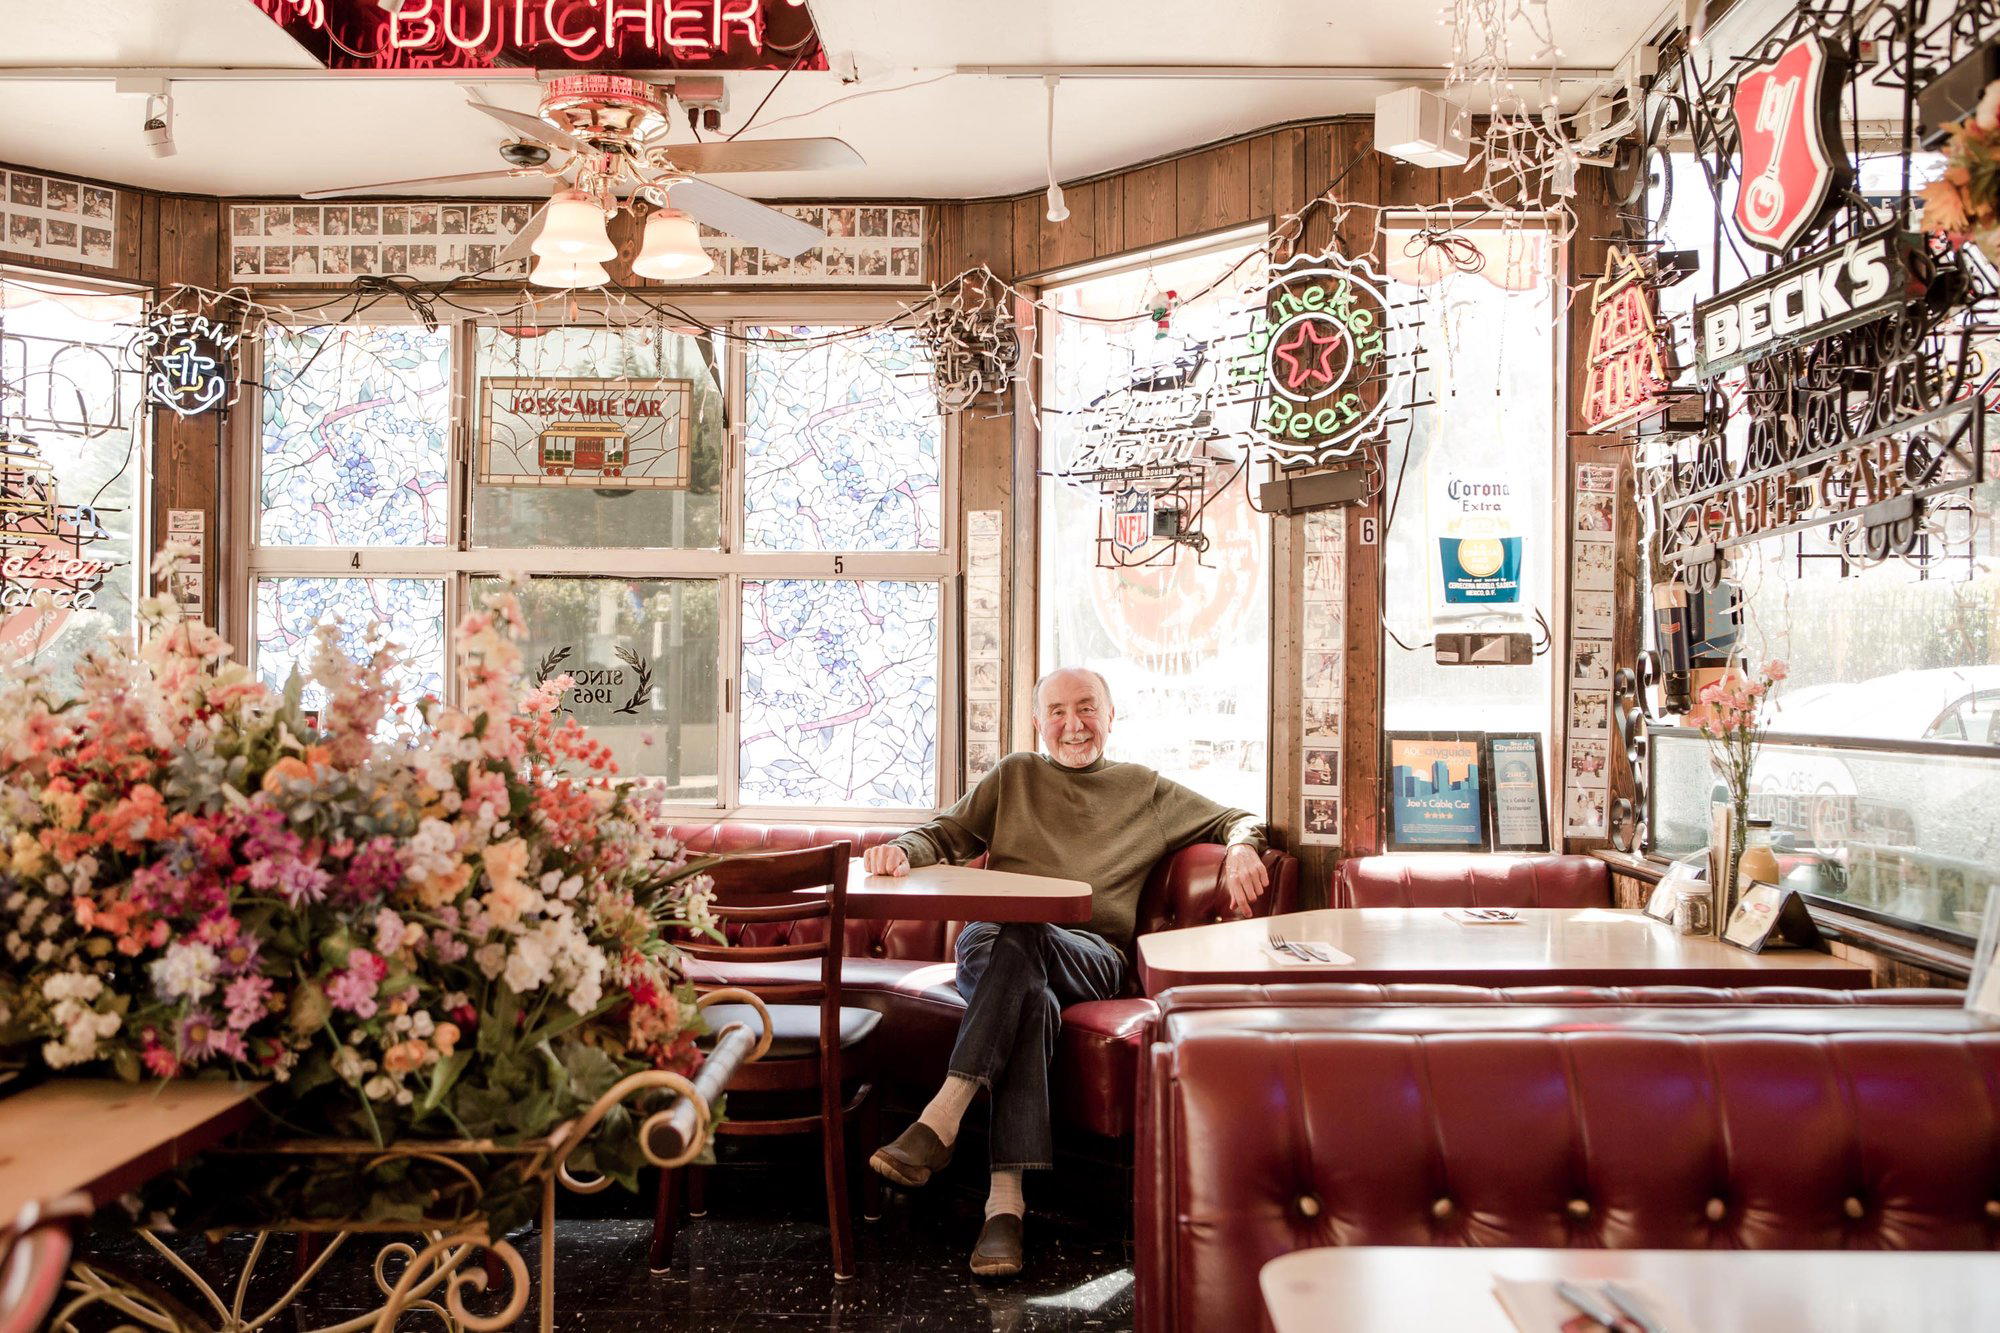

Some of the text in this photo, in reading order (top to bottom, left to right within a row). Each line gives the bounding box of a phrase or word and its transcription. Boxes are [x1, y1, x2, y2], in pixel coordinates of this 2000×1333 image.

[388, 0, 763, 49] BUTCHER
[1705, 240, 1890, 362] BECK'S
[1231, 279, 1384, 387] Heineken
[623, 398, 664, 417] CAR
[1259, 394, 1361, 439] Beer
[1142, 468, 1171, 477] PONSOR
[1448, 479, 1510, 501] Corona
[1703, 437, 1904, 541] CABLE CAR
[1462, 500, 1502, 513] Extra
[1117, 514, 1146, 546] NFL
[1363, 519, 1374, 543] 6
[351, 552, 361, 570] 4
[834, 556, 843, 574] 5
[1406, 799, 1470, 809] Joe's Cable Car
